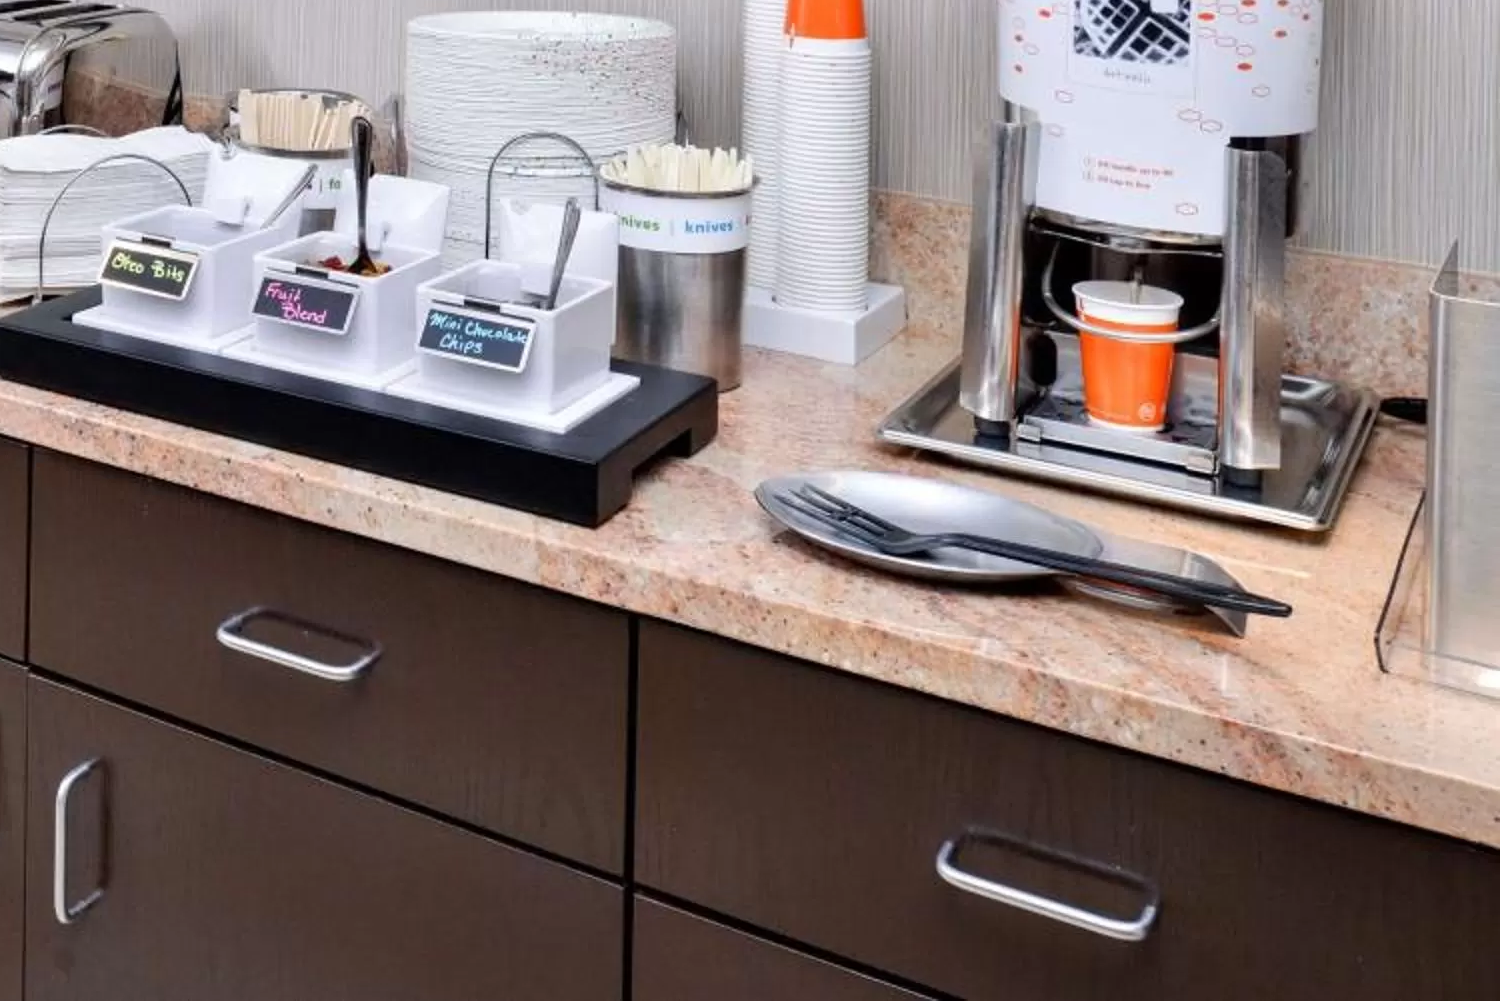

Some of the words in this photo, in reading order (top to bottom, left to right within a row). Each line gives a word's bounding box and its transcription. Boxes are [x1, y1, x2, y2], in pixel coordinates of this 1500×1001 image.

[618, 212, 661, 232] nives
[684, 219, 734, 234] knives
[150, 260, 185, 282] Bits
[265, 282, 302, 301] Fruit
[281, 301, 328, 324] Blend
[429, 312, 463, 330] Mini
[464, 320, 528, 344] Chocolate
